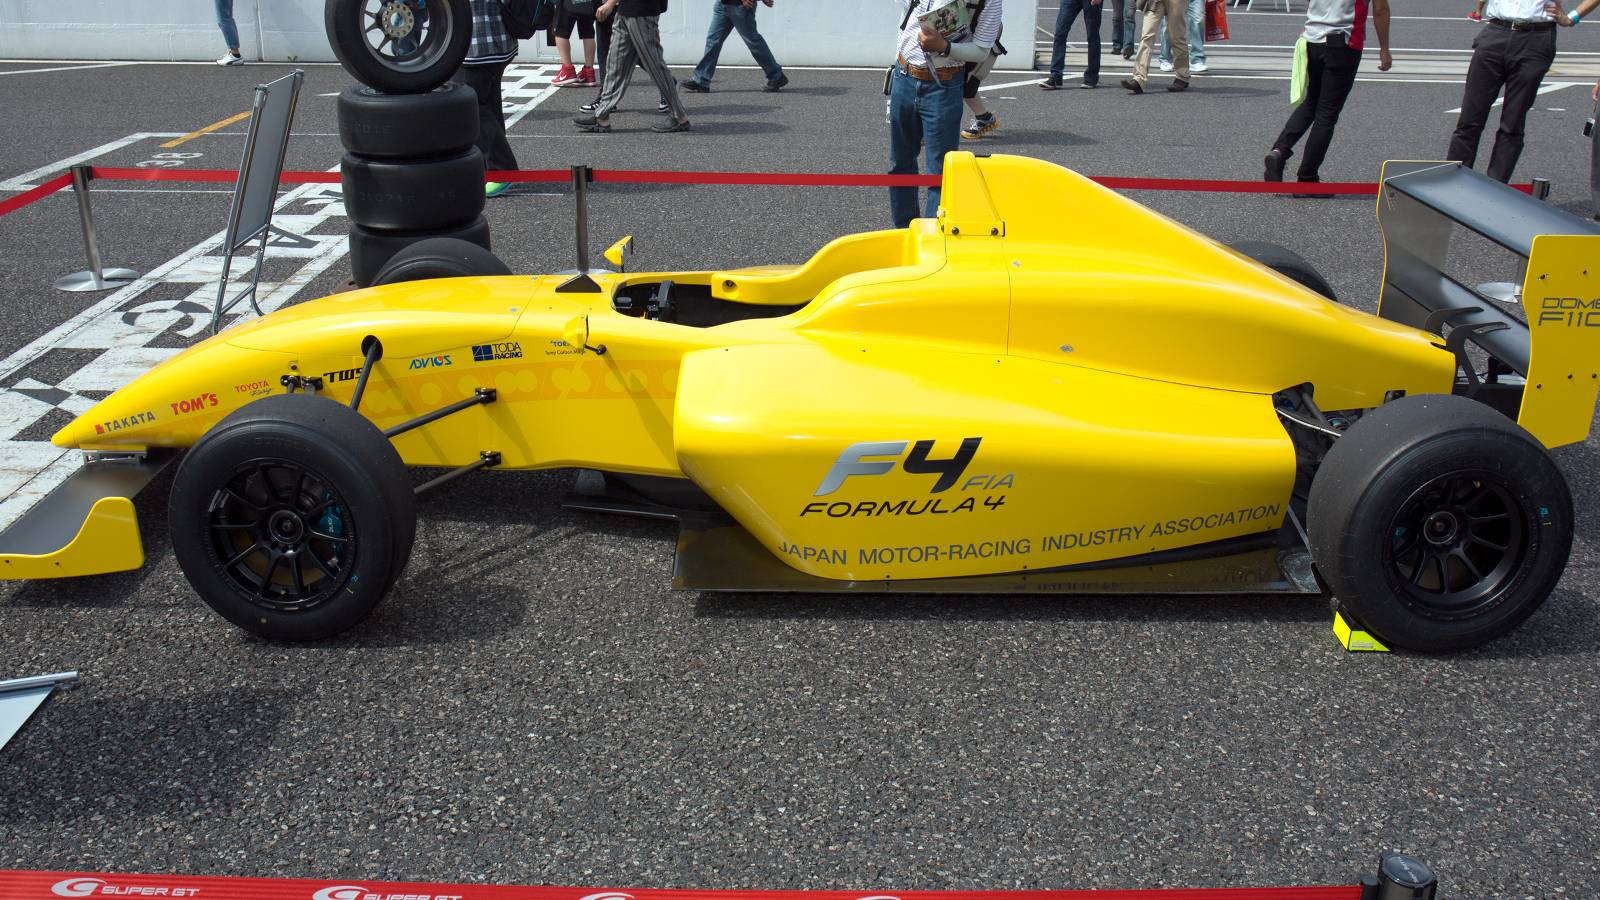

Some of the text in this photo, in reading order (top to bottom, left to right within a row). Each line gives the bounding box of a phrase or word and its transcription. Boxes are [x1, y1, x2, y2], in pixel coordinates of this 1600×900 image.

[492, 342, 522, 353] TODA
[494, 351, 523, 360] RACING
[409, 355, 452, 370] ADVICS
[235, 380, 270, 392] TOYOTA
[171, 393, 218, 416] TOM'S
[104, 411, 156, 432] TAKATA
[814, 437, 982, 497] F4
[961, 473, 1014, 491] FIA
[799, 495, 1006, 518] FORMULA 4
[778, 503, 1281, 565] JAPAN MOTOR-RACING INDUSTRY ASSOCIATION
[101, 886, 168, 896] SUPER
[171, 888, 200, 897] GT
